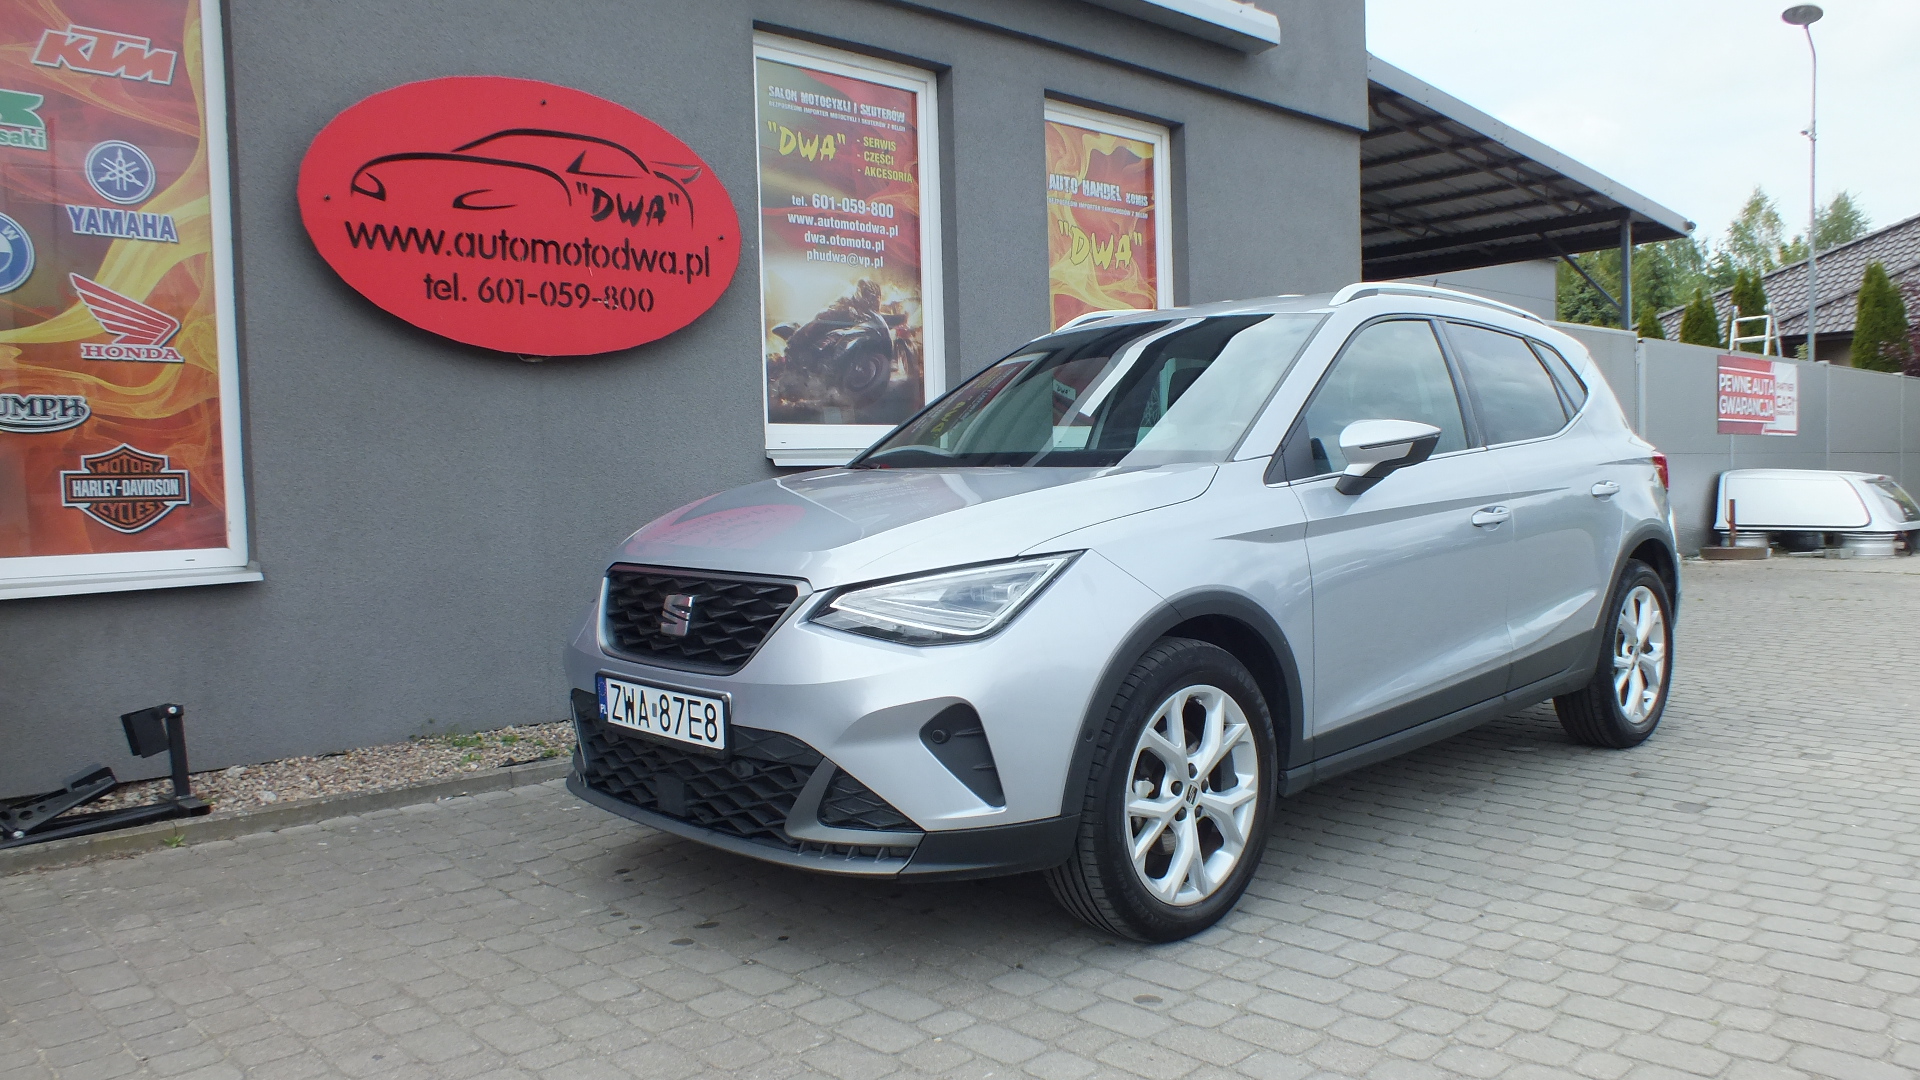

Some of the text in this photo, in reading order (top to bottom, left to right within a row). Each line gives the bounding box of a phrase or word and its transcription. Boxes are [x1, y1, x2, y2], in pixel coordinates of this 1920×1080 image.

[32, 24, 177, 85] KTM
[768, 85, 906, 123] SALON MOTOCYKLI I SKUTERÓW
[767, 120, 847, 162] "DWA"
[863, 136, 897, 152] SERWIS
[863, 151, 894, 166] CZĘŚCI
[864, 166, 913, 184] AKCESORIA
[1049, 173, 1149, 207] AUTO HANDEL KOMIS
[576, 181, 680, 228] "DWA"
[791, 193, 894, 219] tel. 601-059-800
[66, 204, 179, 243] YAMAHA
[787, 213, 899, 237] www.automotodwa.pl
[344, 220, 711, 284] www.automotodwa.pl
[804, 230, 885, 253] dwa.otomoto.pl
[1057, 219, 1143, 270] "DWA"
[806, 249, 884, 269] phudwa@vp.pl
[424, 272, 655, 313] tel. 601-059-800
[81, 343, 185, 362] HONDA
[1718, 373, 1775, 396] PEWNE AUTA
[1719, 394, 1774, 417] GWARANCJA
[96, 460, 155, 474] MOTOR
[71, 478, 180, 498] HARLEY-DAVIDSON
[94, 501, 156, 522] CYCLES
[600, 703, 608, 715] PL
[610, 683, 718, 743] ZWA 87E8
